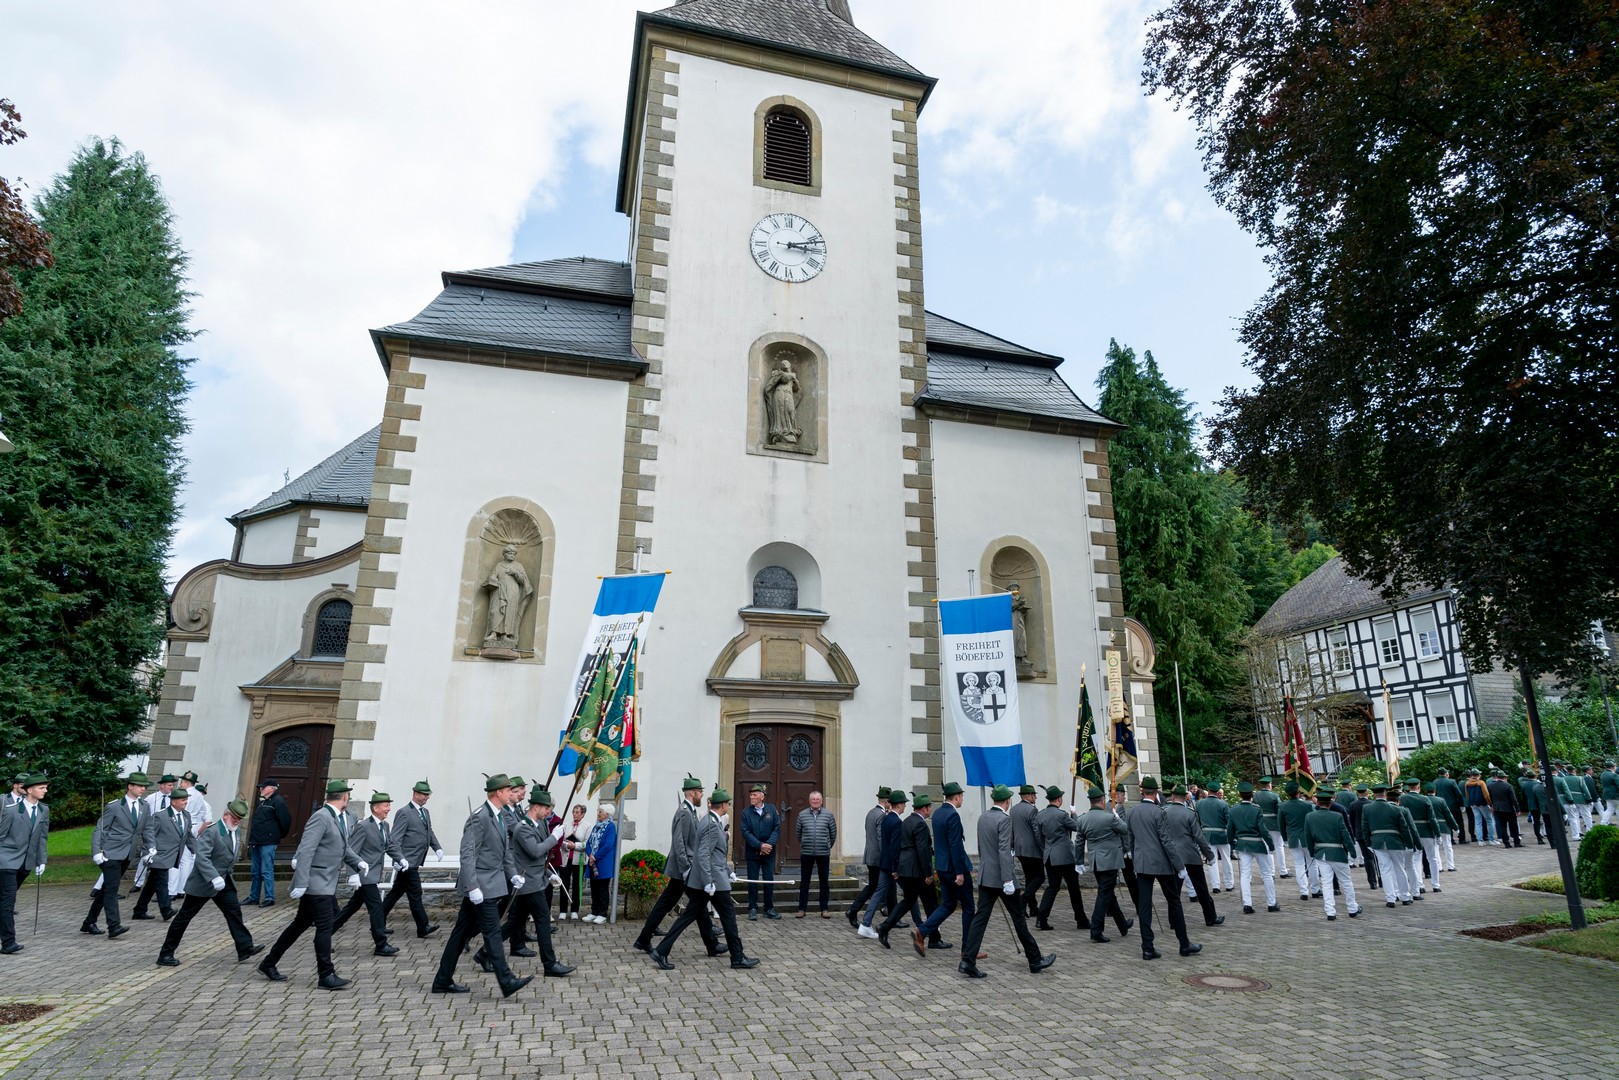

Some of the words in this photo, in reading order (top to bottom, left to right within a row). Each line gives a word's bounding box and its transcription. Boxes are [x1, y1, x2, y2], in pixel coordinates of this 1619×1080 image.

[599, 621, 637, 633] FREHEIT
[956, 640, 1001, 651] FREIHEIT
[955, 651, 1004, 662] BÖDEFELD
